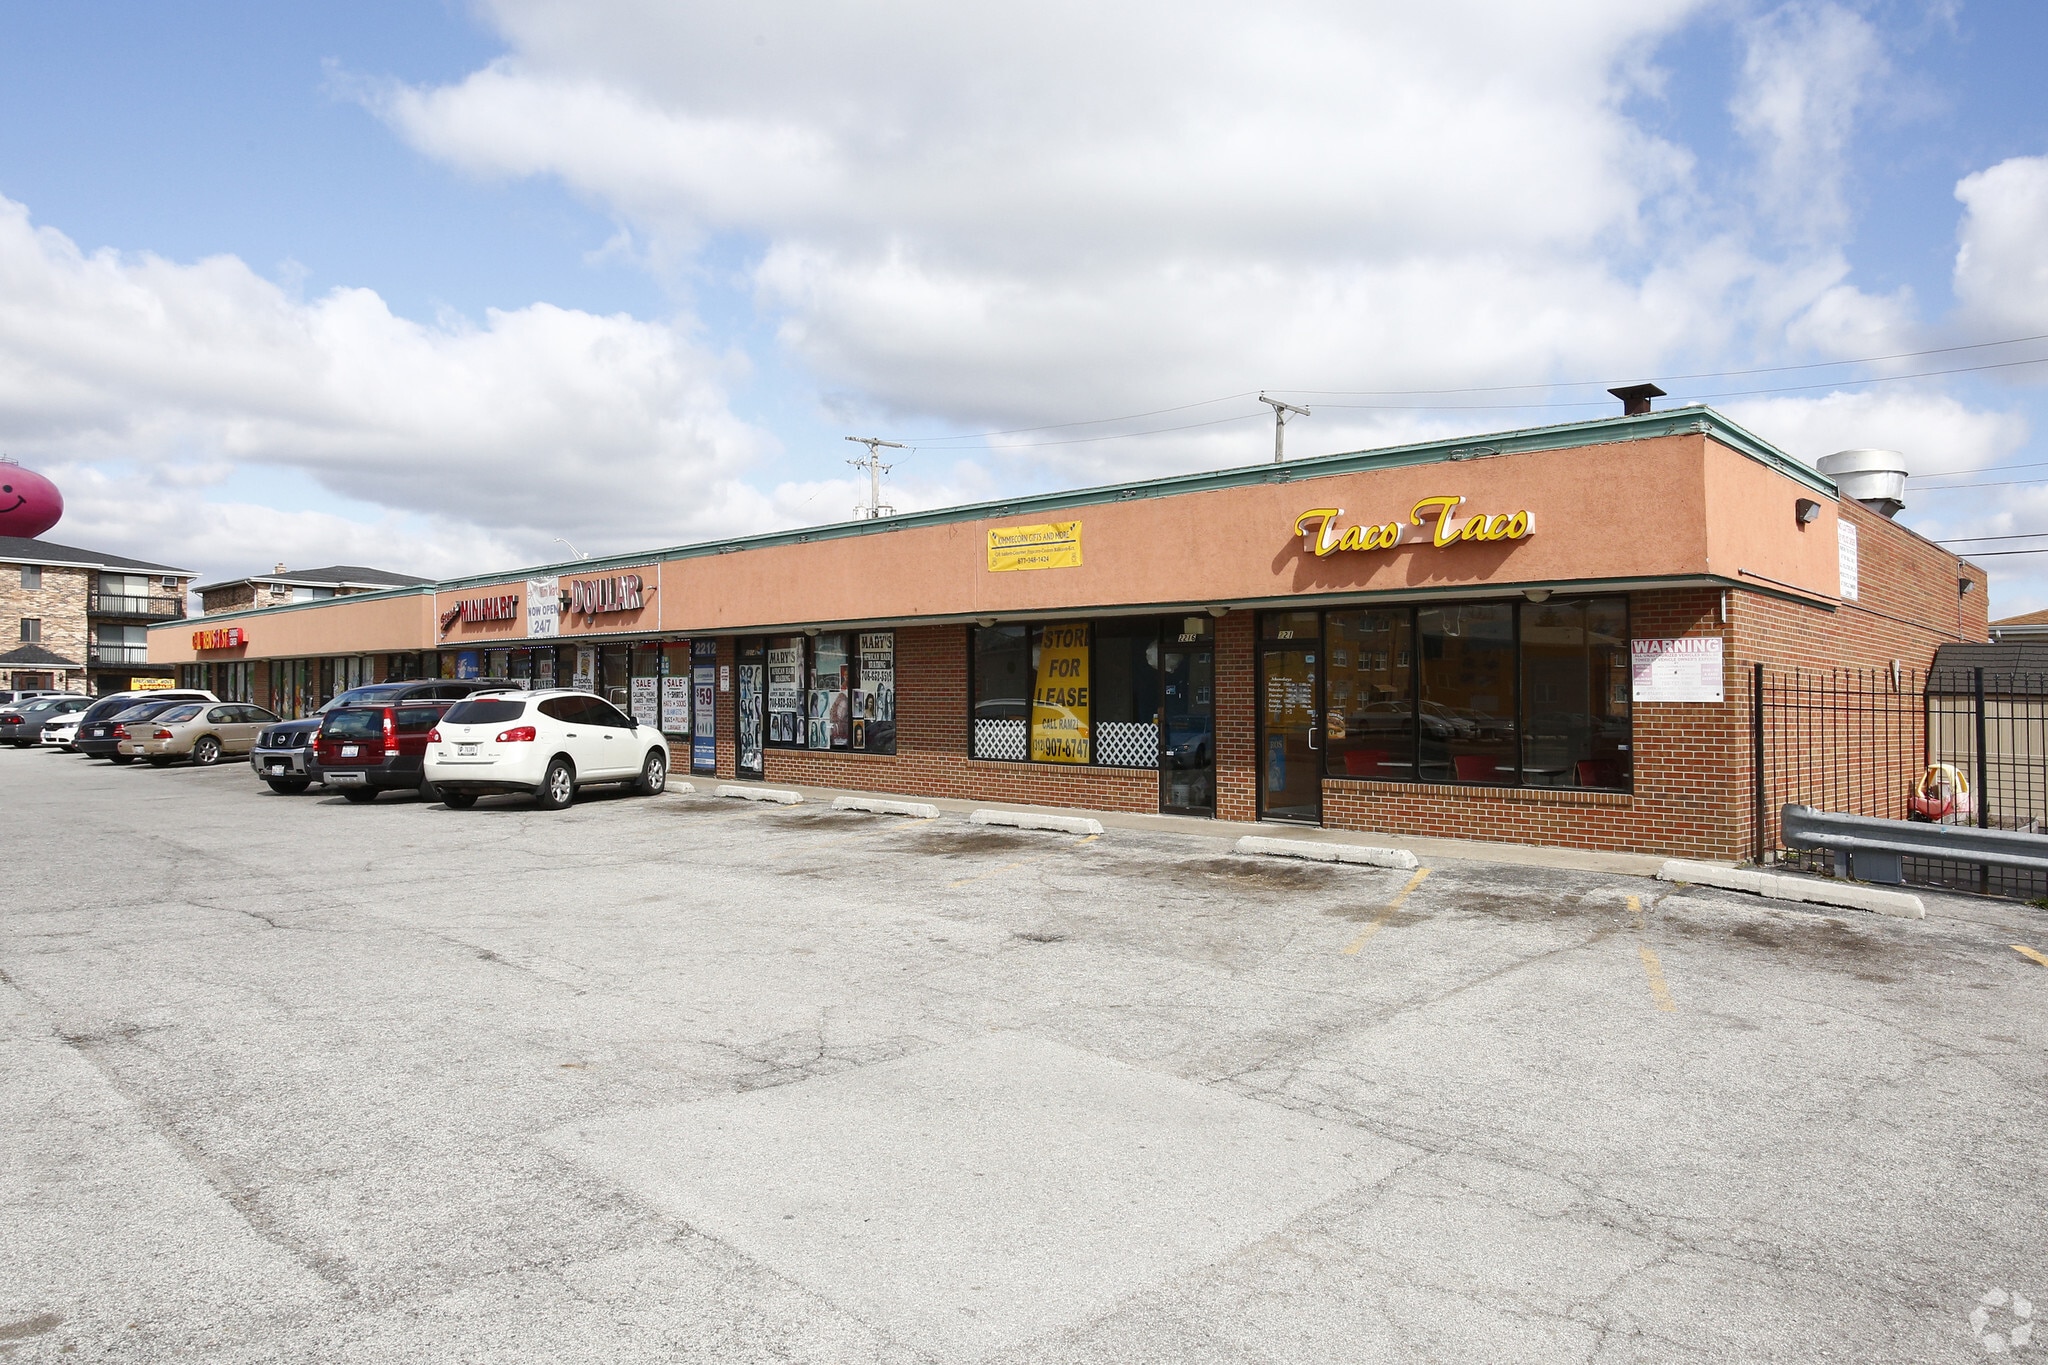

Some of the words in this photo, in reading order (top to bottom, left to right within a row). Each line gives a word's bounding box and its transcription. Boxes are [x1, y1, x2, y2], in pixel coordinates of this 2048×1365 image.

[1295, 508, 1401, 557] Taco
[1410, 496, 1529, 548] Taco
[1028, 533, 1042, 542] GIFTS
[1043, 532, 1054, 541] AND
[1055, 530, 1069, 540] MORE
[572, 575, 643, 614] DOLLAR
[528, 606, 541, 617] NOW
[542, 604, 559, 616] OPEN
[534, 619, 551, 634] 24/7
[695, 641, 717, 655] 2212
[862, 635, 892, 649] MARY'S
[1633, 639, 1720, 653] WARNING
[769, 651, 796, 665] MARY'S
[1049, 658, 1081, 678] FOR
[635, 679, 652, 688] SALE
[666, 678, 683, 688] SALE
[666, 690, 684, 699] T-SHIRTS
[696, 687, 713, 706] $59
[1036, 687, 1088, 708] LEASE
[1042, 718, 1058, 730] CALL
[1045, 738, 1089, 759] 907-8747
